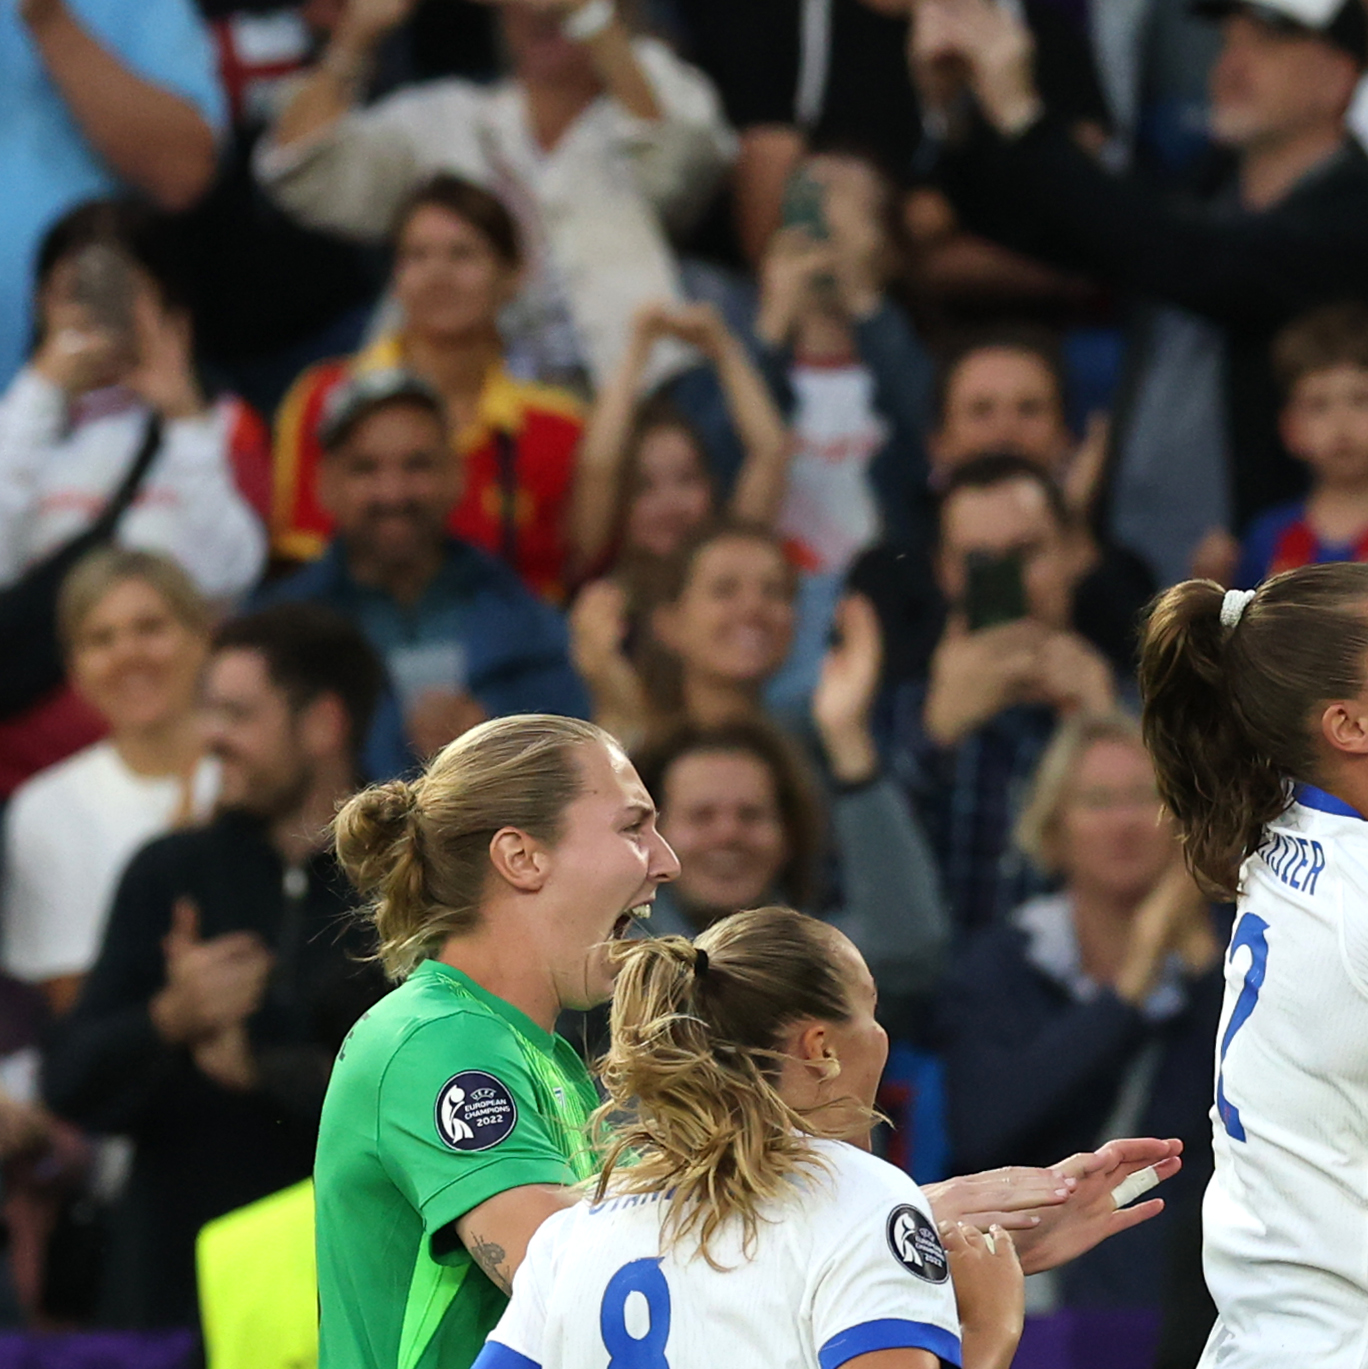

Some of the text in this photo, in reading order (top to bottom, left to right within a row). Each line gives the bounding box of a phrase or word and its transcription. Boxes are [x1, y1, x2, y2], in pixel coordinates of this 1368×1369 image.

[470, 1087, 497, 1101] UEFA
[464, 1098, 507, 1113] EUROPEAN
[464, 1105, 511, 1120] CHAMPIONS
[476, 1114, 504, 1127] 2022
